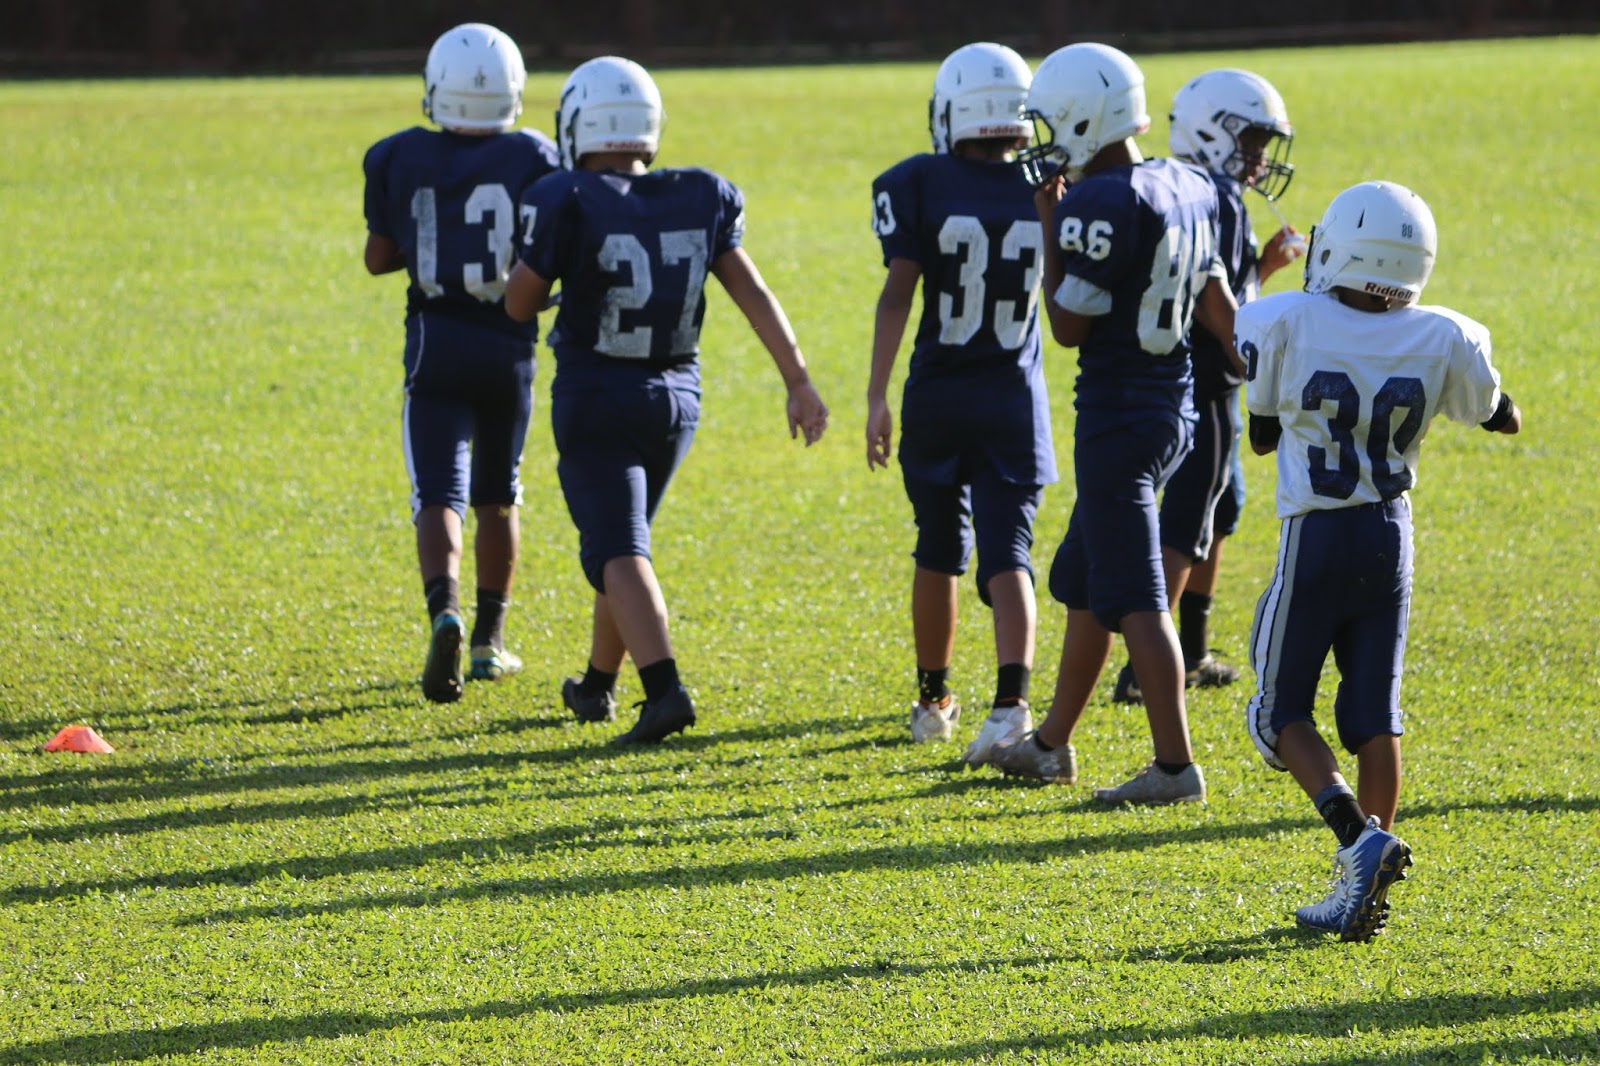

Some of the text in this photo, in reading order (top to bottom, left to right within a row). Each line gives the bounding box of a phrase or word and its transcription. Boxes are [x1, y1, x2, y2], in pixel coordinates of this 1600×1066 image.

[410, 183, 514, 303] 13
[594, 228, 708, 358] 27
[938, 215, 1044, 349] 33
[1059, 216, 1114, 261] 86
[1364, 281, 1413, 301] Riddell
[1302, 370, 1426, 500] 30
